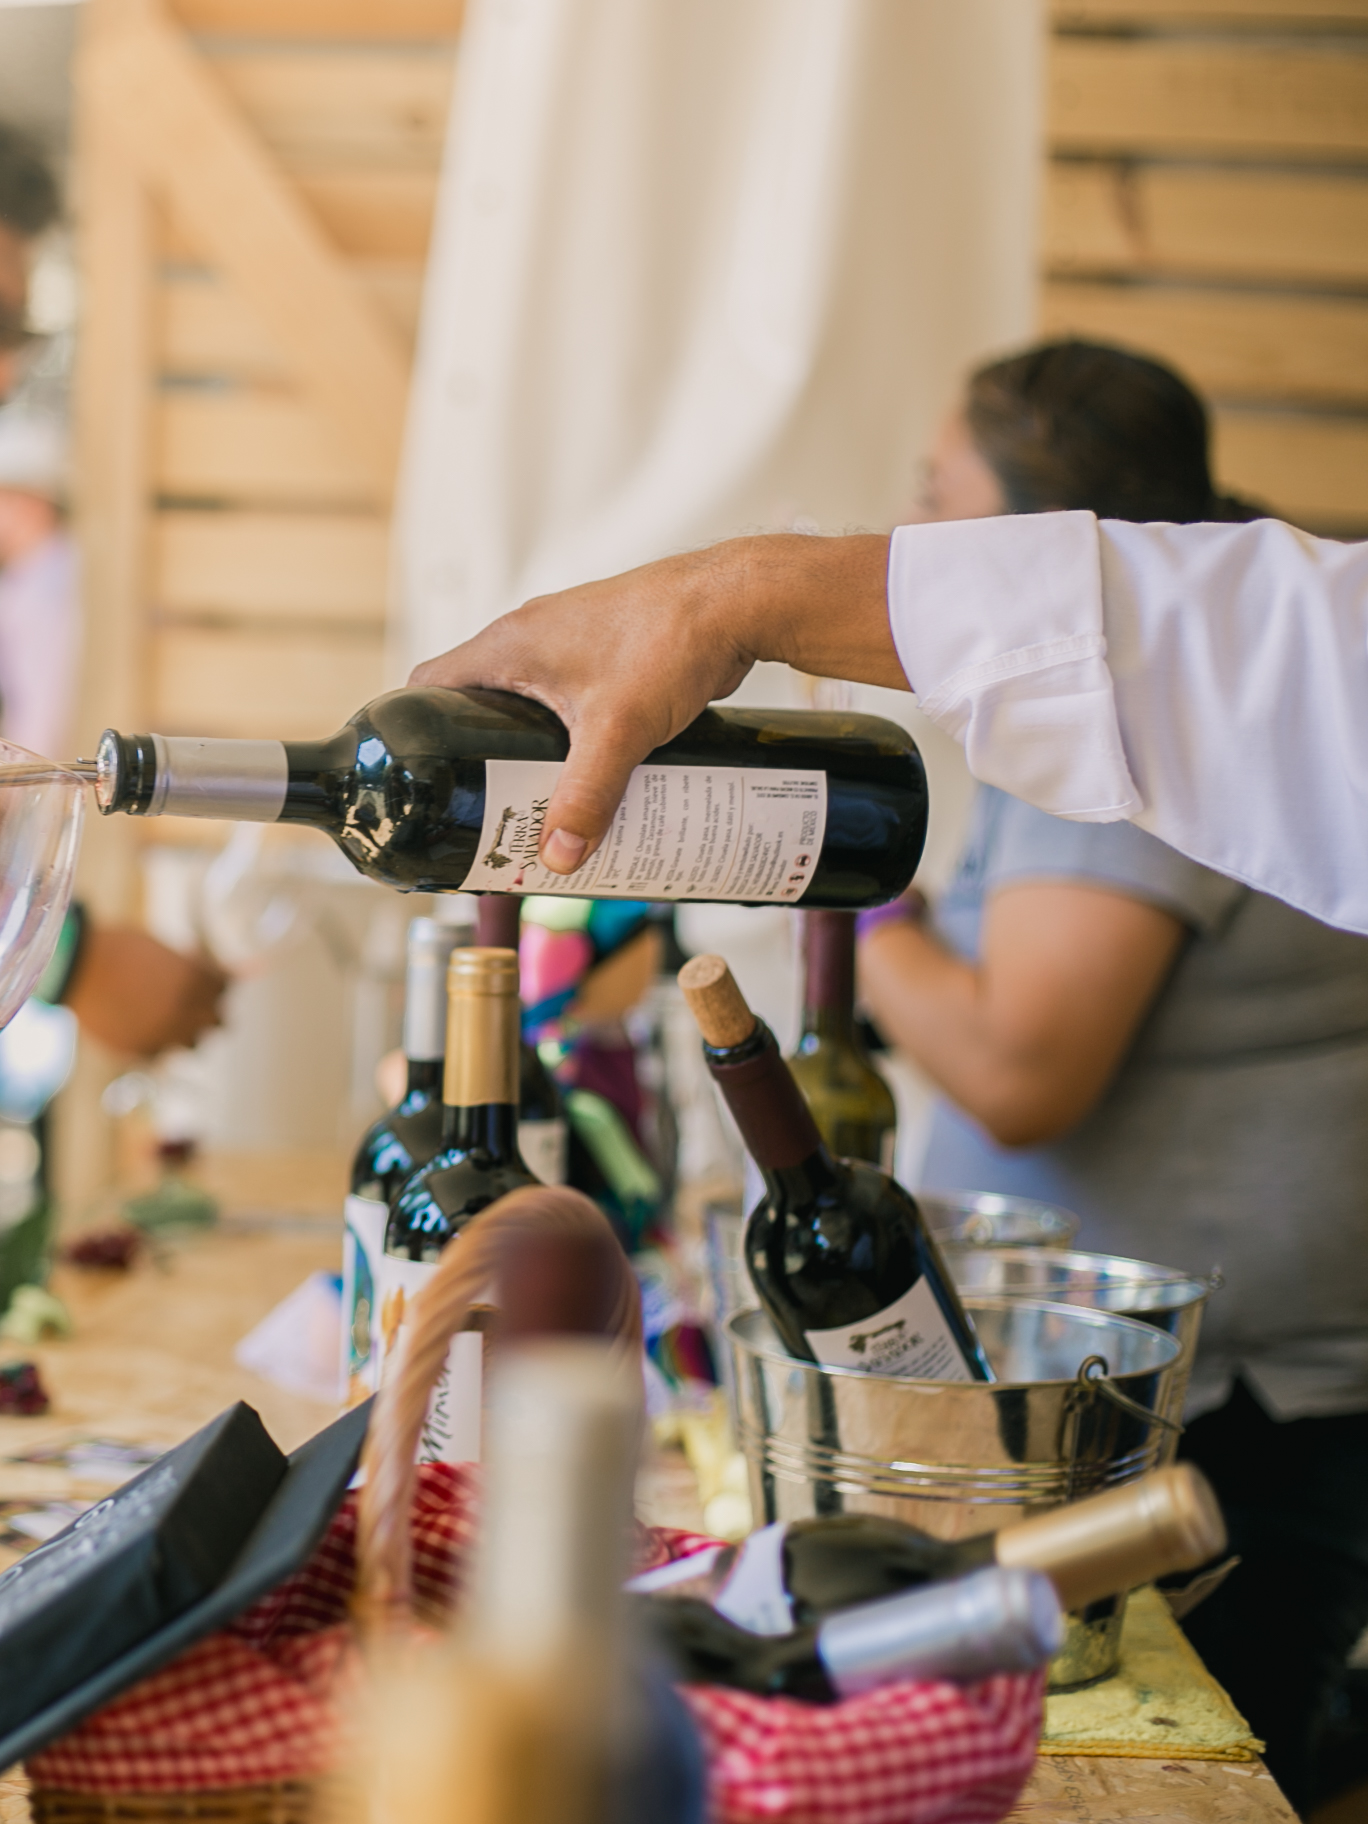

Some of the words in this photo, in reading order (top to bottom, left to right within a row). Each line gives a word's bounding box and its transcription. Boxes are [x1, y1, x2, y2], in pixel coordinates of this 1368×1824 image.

[651, 774, 658, 782] de
[660, 774, 666, 782] de
[650, 786, 658, 803] nieve
[658, 784, 666, 813] cubiertos
[727, 781, 735, 805] mentol.
[619, 807, 627, 820] para
[704, 787, 712, 822] mermelada
[635, 824, 647, 852] Chocolate
[642, 796, 651, 821] amargo,
[647, 808, 657, 840] Zarzamora,
[656, 815, 664, 827] café
[726, 812, 734, 825] dátil
[799, 810, 810, 845] PRODUCTO
[509, 816, 528, 855] TERRA
[520, 798, 548, 871] SALVADOR
[677, 816, 688, 842] brillante,
[701, 826, 710, 841] pasa,
[708, 825, 718, 843] buena
[724, 827, 732, 842] pasa,
[695, 843, 706, 863] Ciruela
[717, 844, 729, 863] Ciruela
[750, 832, 763, 862] SALVADOR
